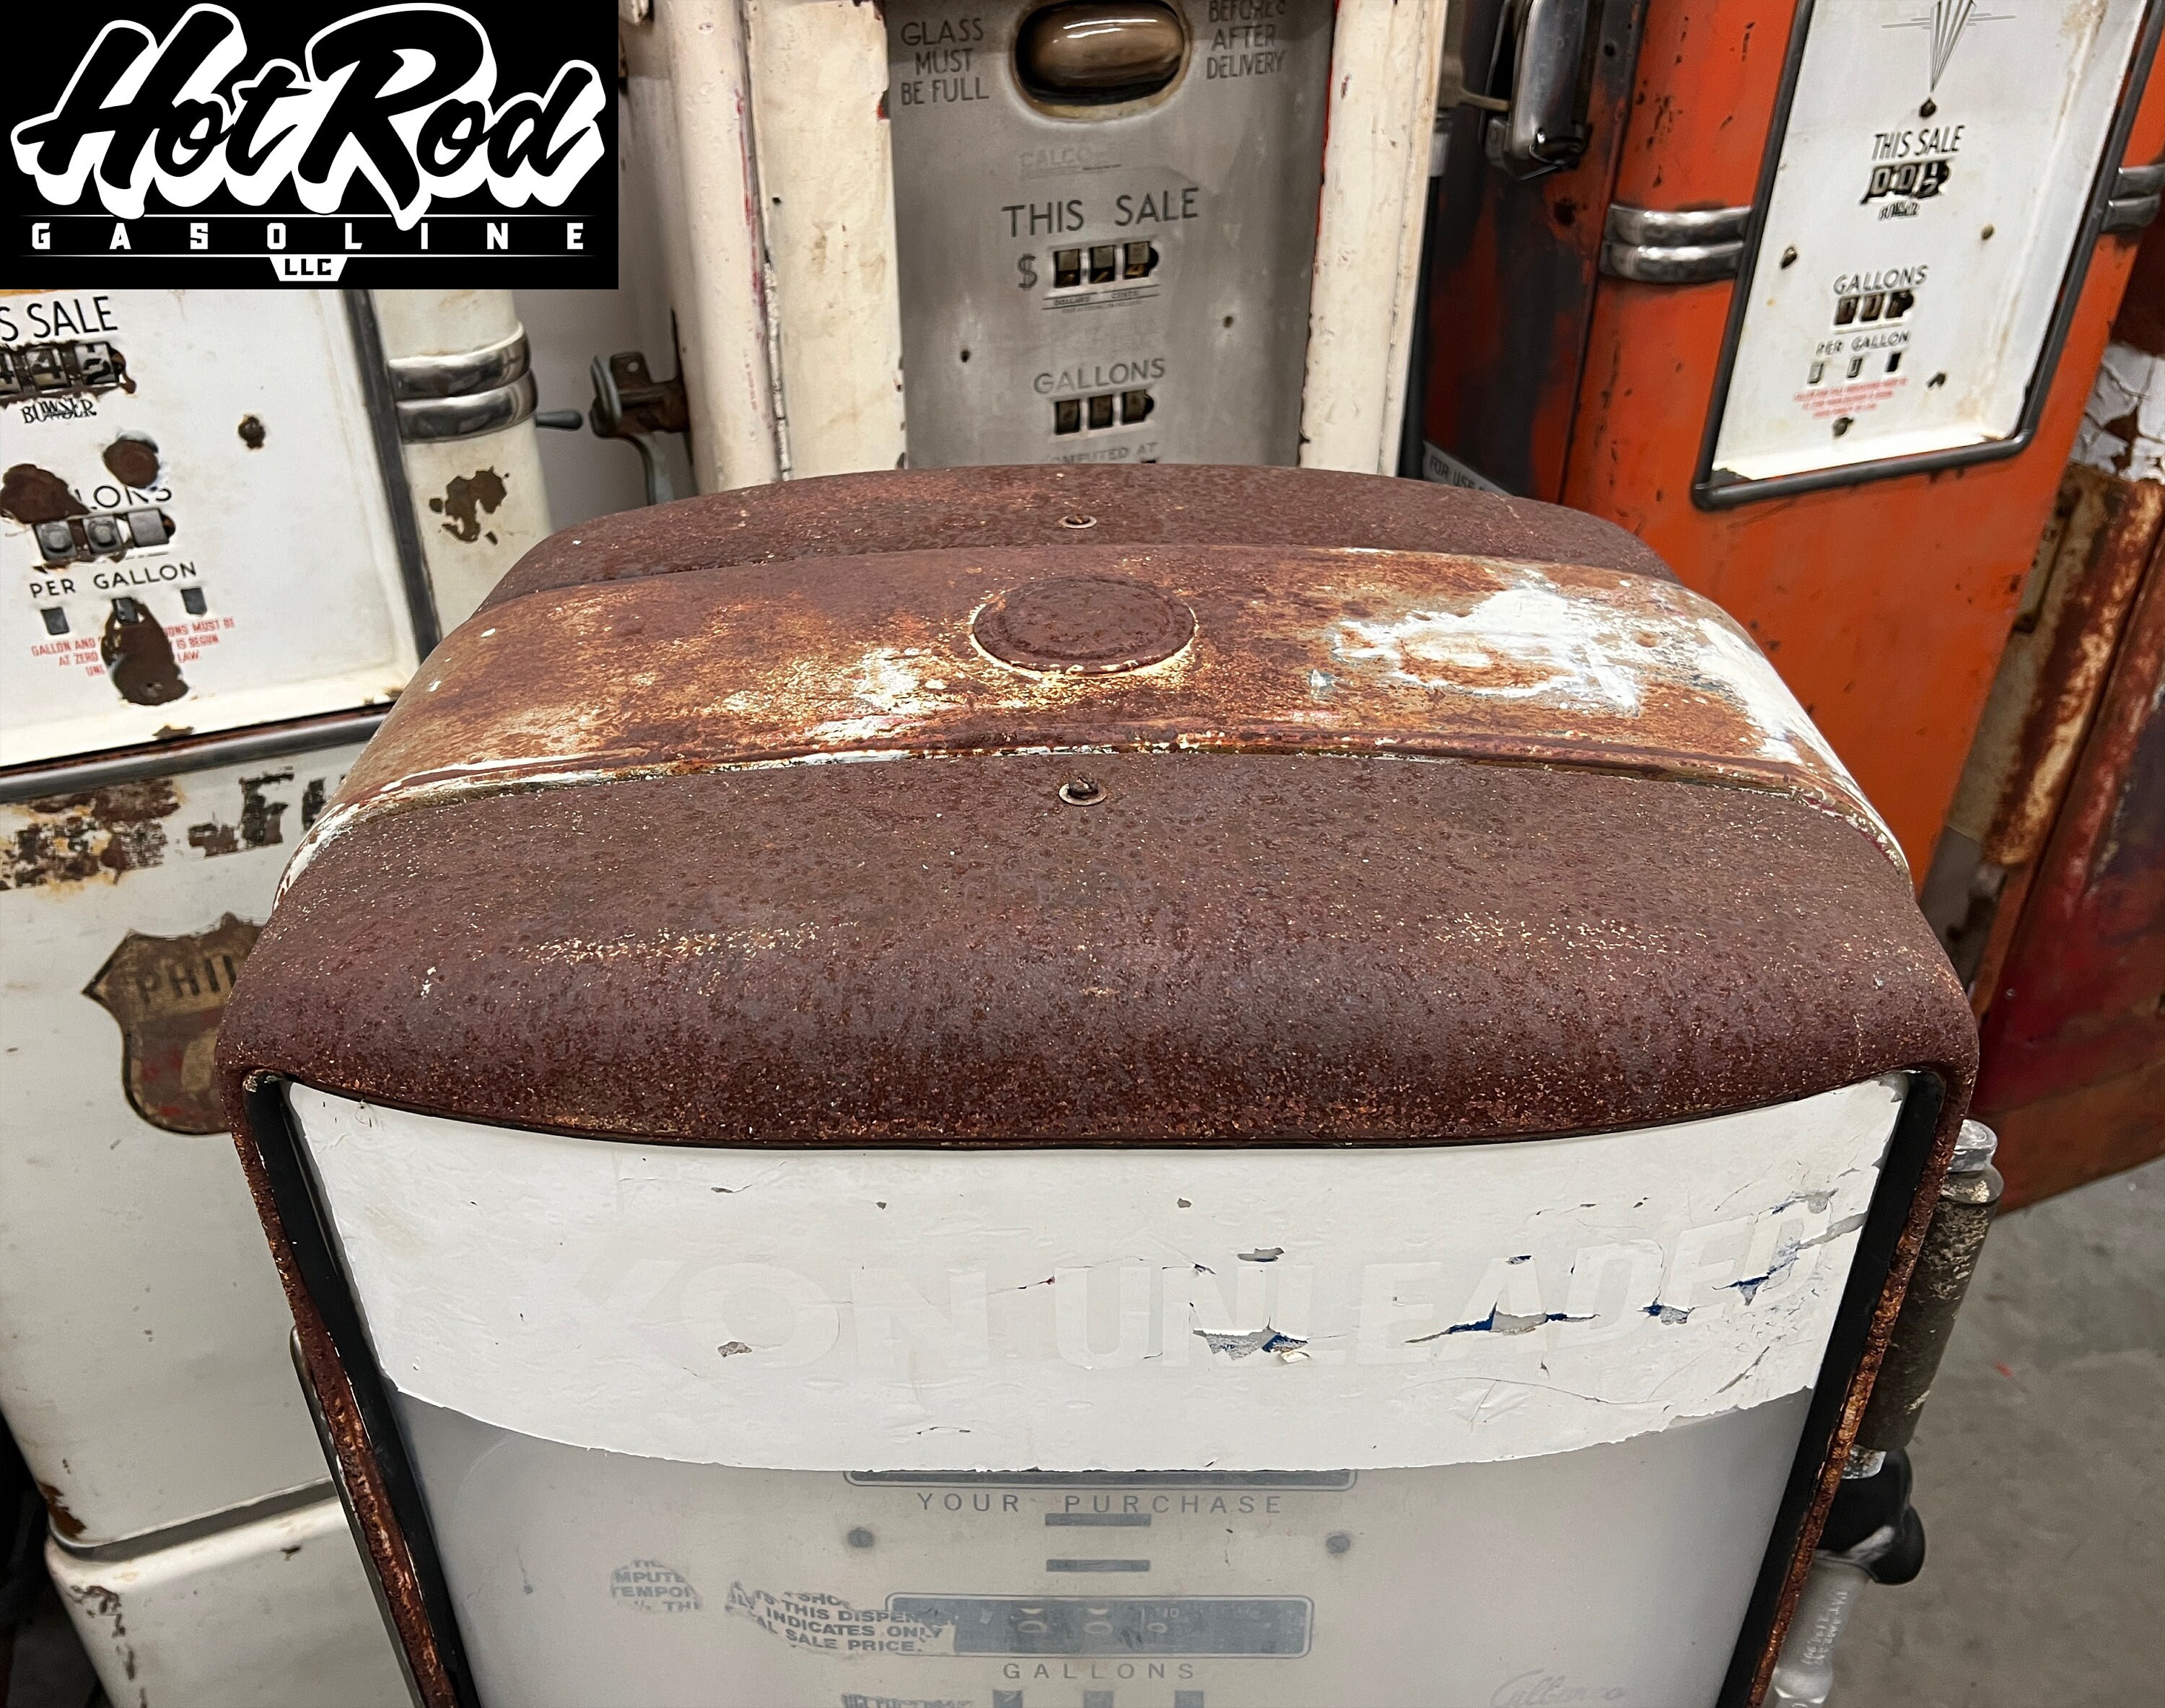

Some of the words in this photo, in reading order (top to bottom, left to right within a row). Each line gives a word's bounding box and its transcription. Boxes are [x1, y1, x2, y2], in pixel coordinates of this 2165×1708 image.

[901, 19, 984, 46] GLASS
[1211, 24, 1275, 51] AFTER
[914, 49, 971, 74] MUST
[1206, 50, 1285, 79] DELIVERY
[901, 82, 924, 105] BE
[930, 76, 989, 102] FULL
[1871, 131, 1912, 161] THIS
[1914, 124, 1965, 156] SALE
[1002, 199, 1085, 239] THIS
[1114, 187, 1199, 227] SALE
[1017, 253, 1038, 290] $
[1833, 264, 1929, 295] GALLONS
[27, 295, 118, 338] SALE
[1815, 340, 1844, 356] PER
[1851, 330, 1910, 352] GALLON
[1033, 358, 1166, 395] GALLONS
[1430, 455, 1449, 479] FOR
[30, 579, 76, 598] PER
[93, 561, 197, 590] GALLON
[193, 619, 220, 633] MUST
[31, 641, 72, 657] GALLON
[74, 637, 96, 649] AND
[188, 634, 219, 647] BEGUN
[58, 654, 70, 666] AT
[75, 651, 99, 665] ZERO
[177, 651, 200, 663] LAW
[1054, 1206, 1826, 1370] UNLEADED
[917, 1492, 1019, 1512] YOUR
[1064, 1495, 1282, 1514] PURCHASE
[766, 1606, 875, 1637] INDICATES
[886, 1625, 943, 1638] ONLY
[781, 1599, 831, 1621] THIS
[784, 1628, 837, 1649] SALE
[847, 1639, 923, 1652] PRICE.
[1002, 1663, 1194, 1680] GALLONS
